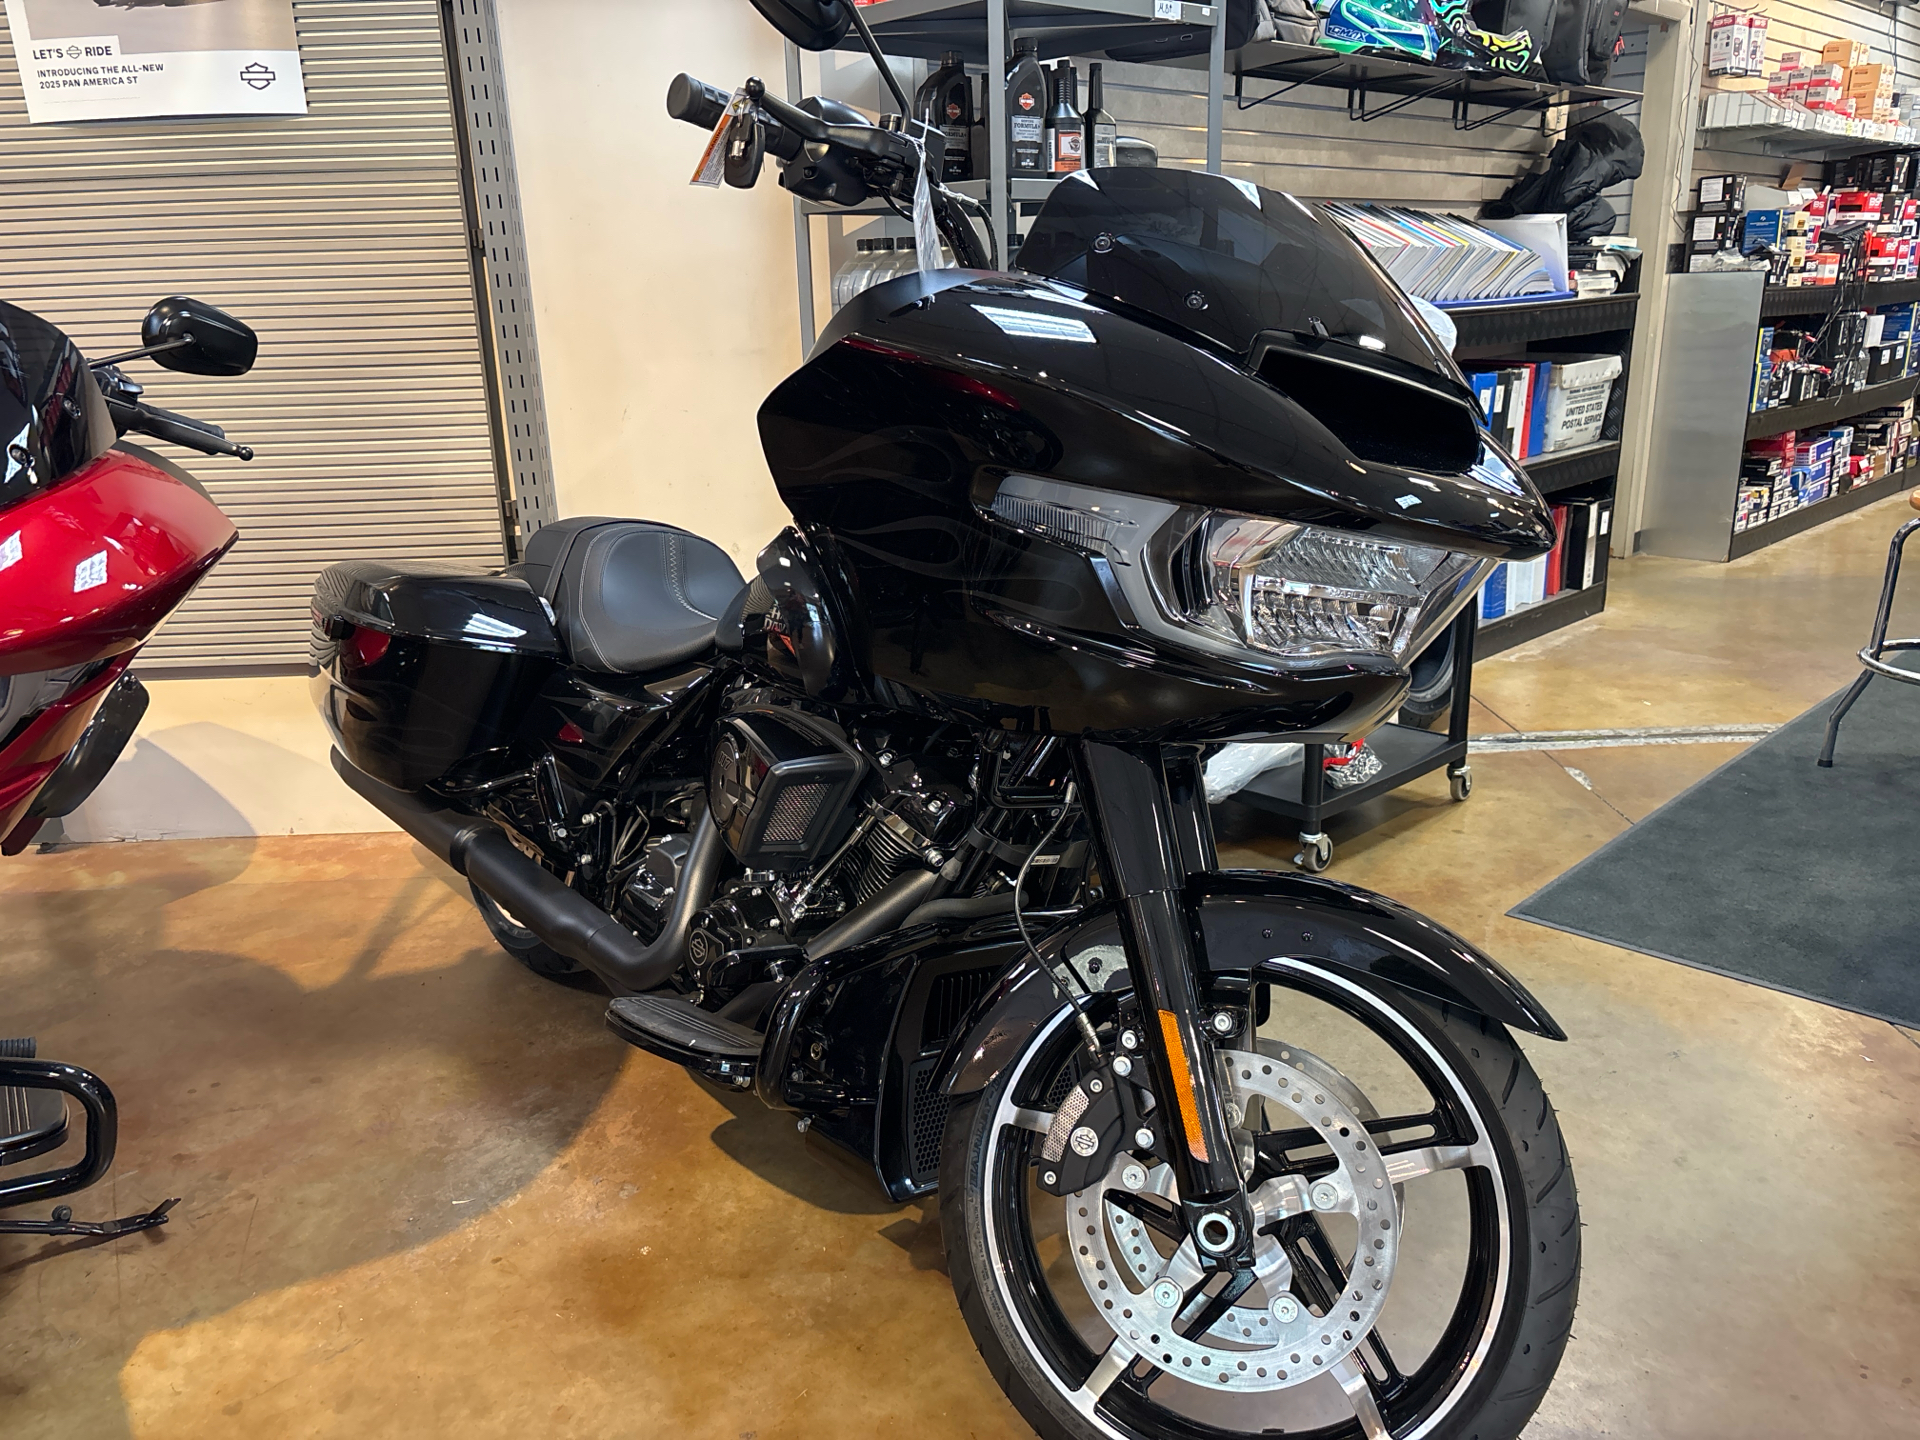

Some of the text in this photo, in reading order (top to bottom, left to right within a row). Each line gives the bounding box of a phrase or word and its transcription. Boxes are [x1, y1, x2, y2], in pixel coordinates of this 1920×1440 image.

[32, 45, 113, 60] LET'S RIDE
[37, 63, 164, 78] INTRODUCING THE ALL-NEW
[39, 75, 138, 89] 2025 PAN AMERICA ST
[1813, 200, 1825, 208] BS
[1565, 401, 1604, 418] UNITED STATES
[1560, 416, 1583, 430] POSTAL
[1583, 412, 1604, 426] SERVICE
